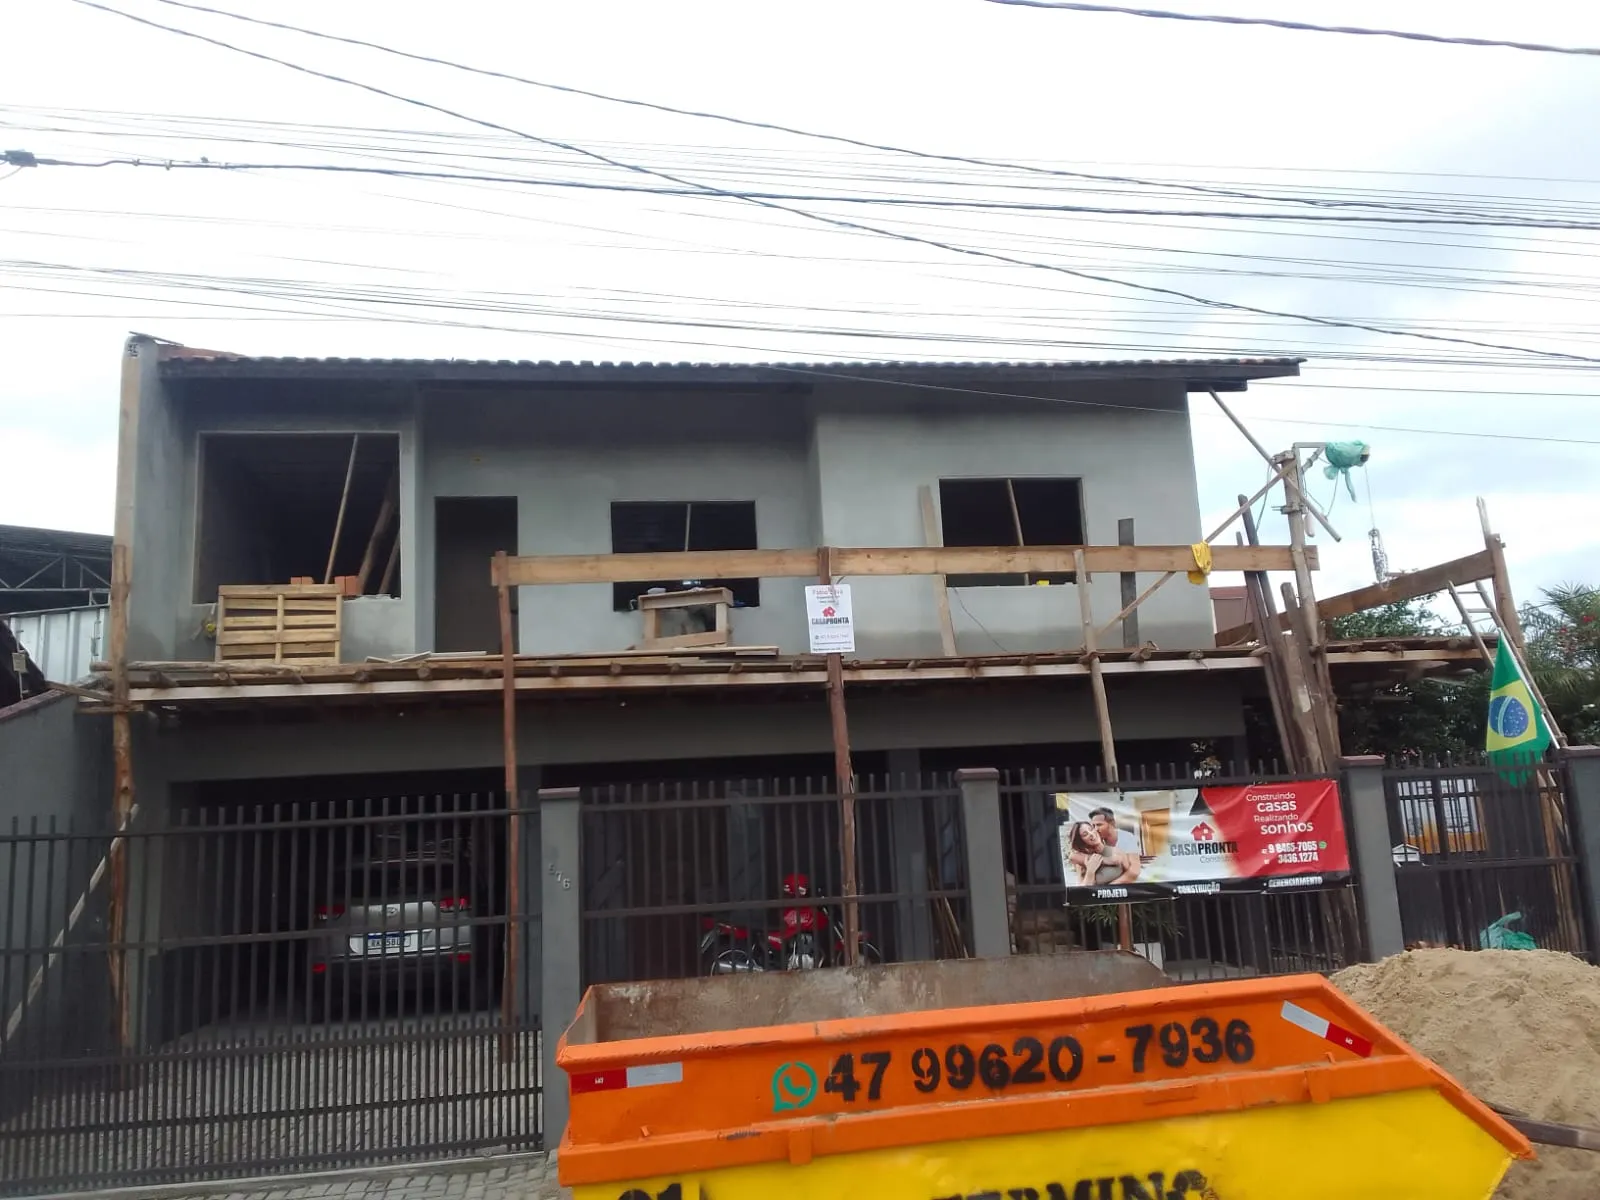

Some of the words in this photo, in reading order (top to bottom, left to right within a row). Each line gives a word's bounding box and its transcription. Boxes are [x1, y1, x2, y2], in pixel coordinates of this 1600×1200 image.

[1246, 791, 1296, 802] Construindo
[1257, 800, 1297, 812] casas
[1253, 813, 1298, 823] Realizando
[1260, 821, 1314, 835] sonhos
[1170, 841, 1239, 857] CASAPRONTA
[1097, 887, 1128, 898] PROJETO
[824, 1052, 892, 1102] 47
